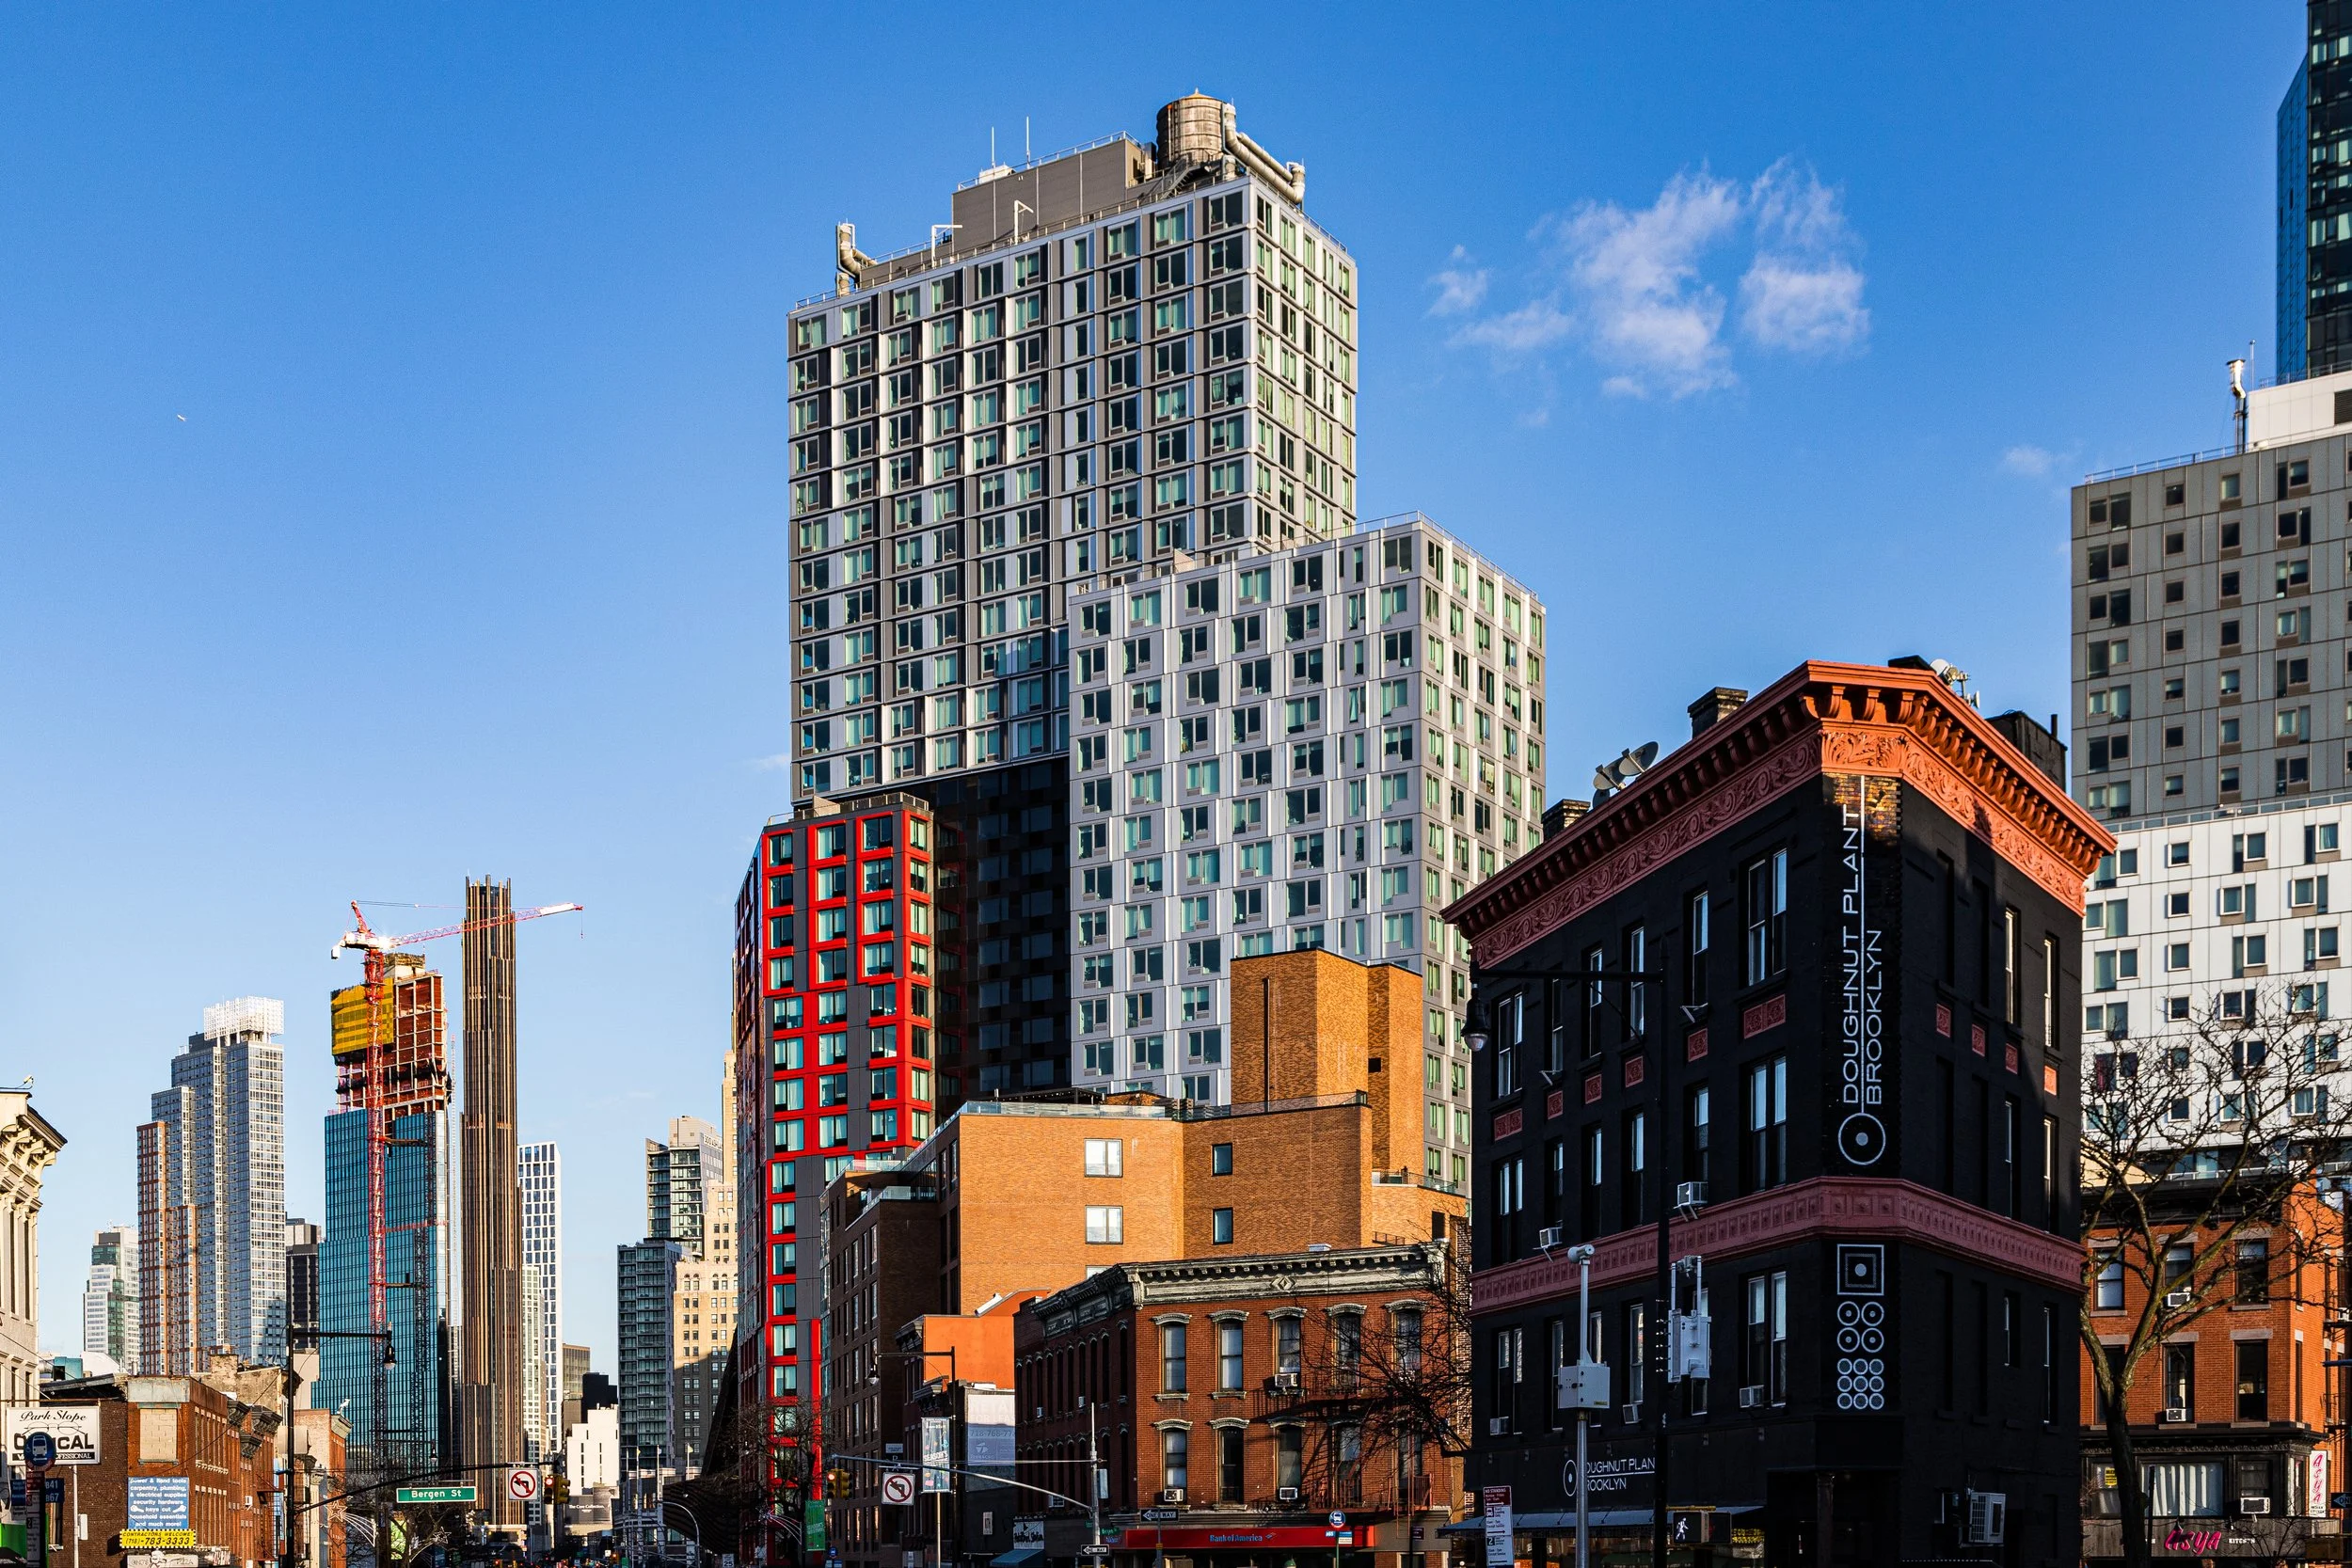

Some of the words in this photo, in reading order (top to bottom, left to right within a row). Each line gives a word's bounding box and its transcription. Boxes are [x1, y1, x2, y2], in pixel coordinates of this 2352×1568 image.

[1843, 803, 1859, 914] PLANT
[1843, 927, 1859, 1103] DOUGHNUT
[1867, 930, 1882, 1104] BROOKLYN
[970, 1400, 1013, 1412] RETAI
[20, 1411, 51, 1421] Park
[53, 1410, 87, 1422] Slope
[14, 1433, 94, 1449] OCAL
[1587, 1459, 1627, 1474] UGHNUT
[1629, 1457, 1656, 1471] PLAN
[1587, 1478, 1627, 1492] OOKLYN
[411, 1490, 445, 1499] Bergen
[451, 1489, 462, 1497] St
[1209, 1534, 1226, 1543] Bank
[1234, 1533, 1263, 1542] America
